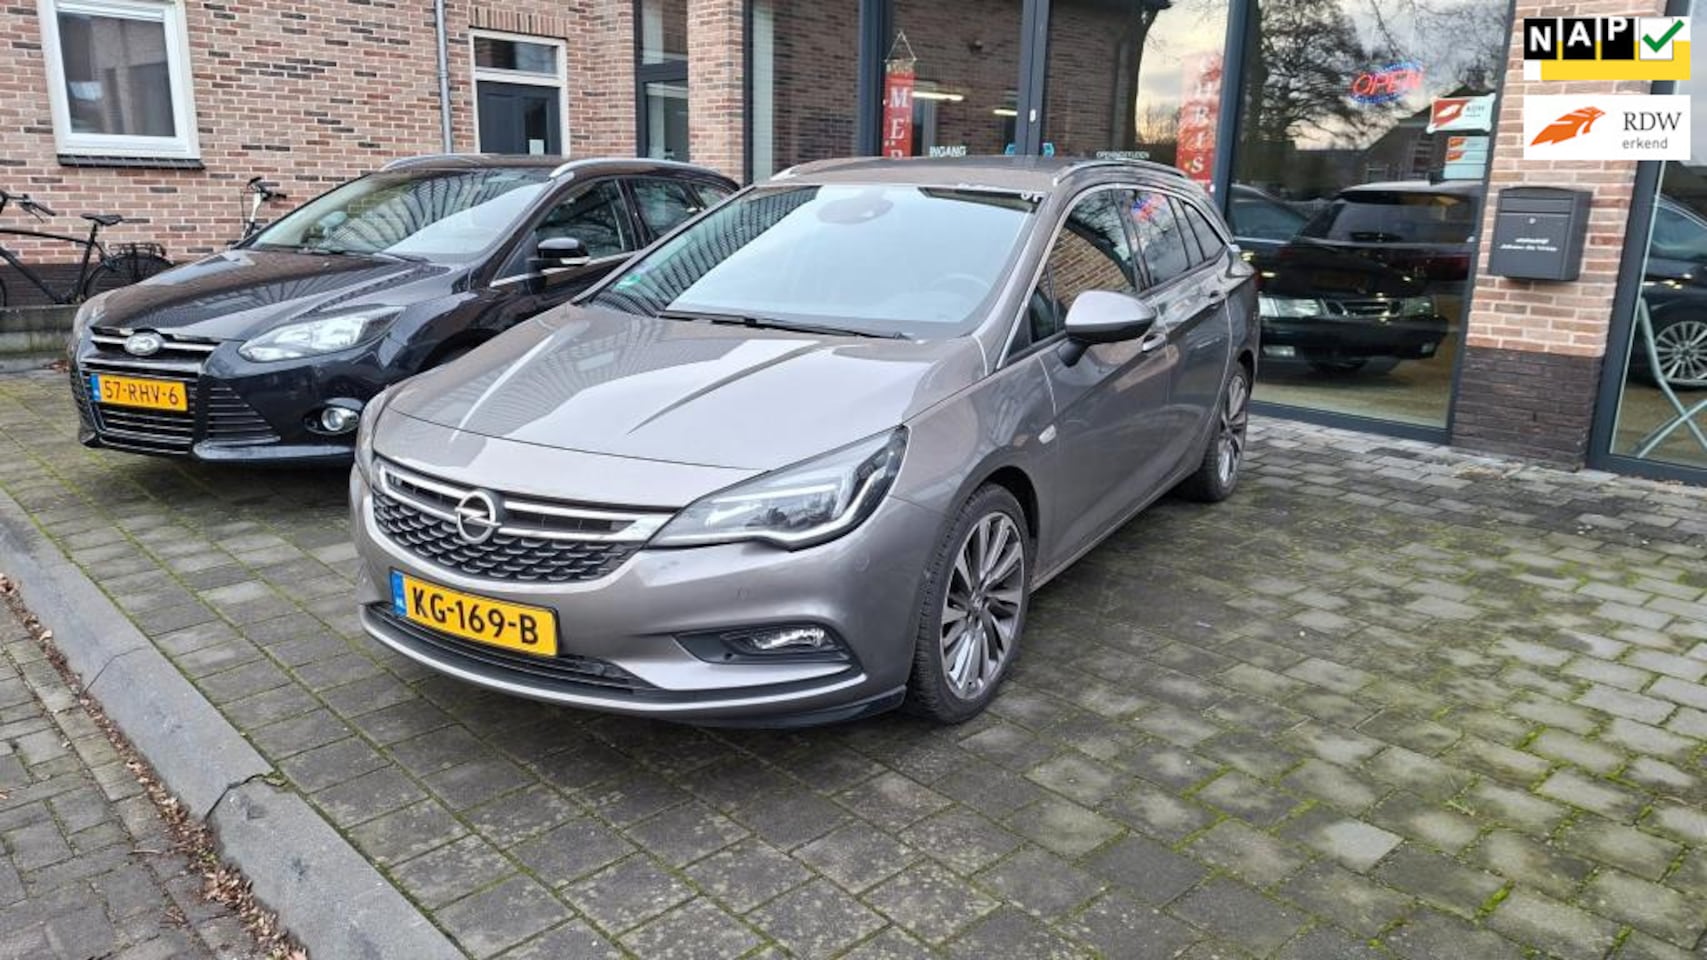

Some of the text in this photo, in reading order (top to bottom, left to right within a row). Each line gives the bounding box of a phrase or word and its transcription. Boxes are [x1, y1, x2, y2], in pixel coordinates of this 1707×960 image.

[1353, 68, 1422, 95] OPEN
[930, 145, 966, 158] INGANG
[104, 380, 179, 405] 57-RHV-6
[412, 586, 539, 645] KG-169-B
